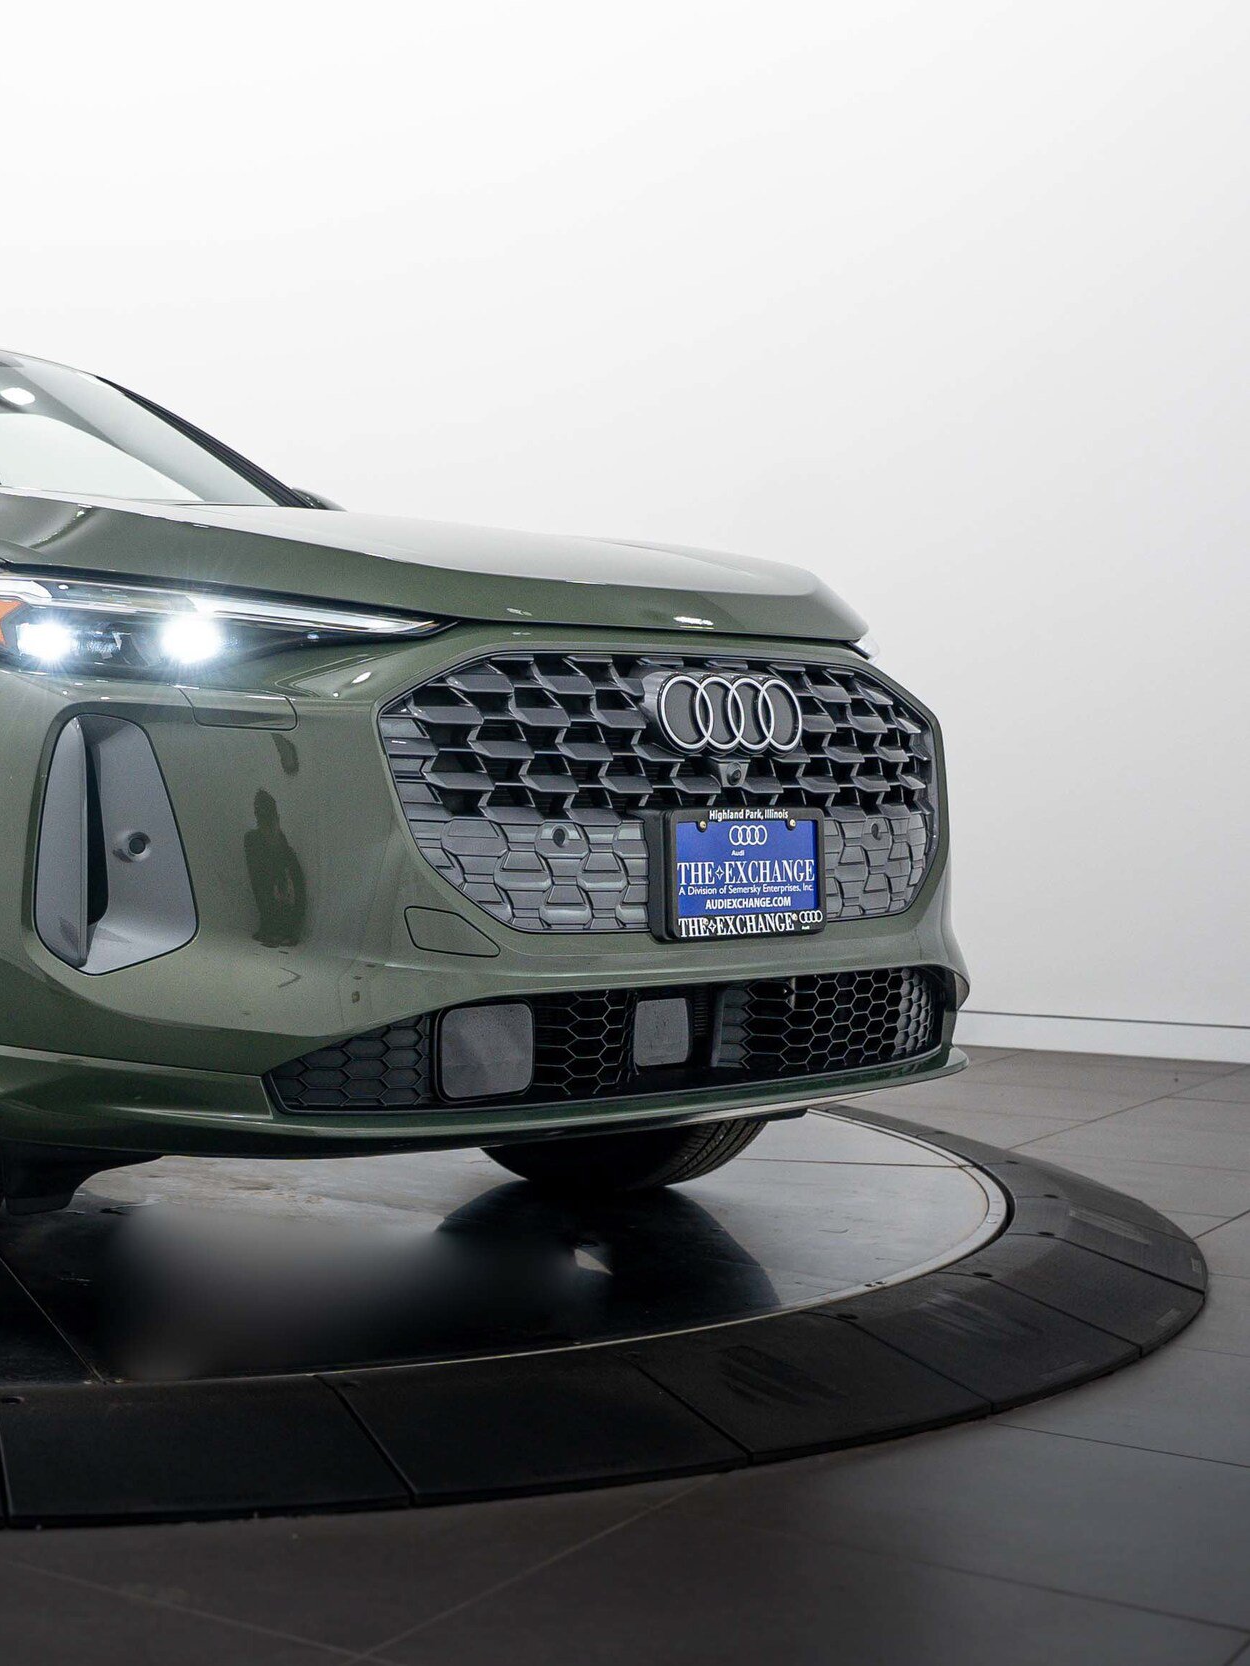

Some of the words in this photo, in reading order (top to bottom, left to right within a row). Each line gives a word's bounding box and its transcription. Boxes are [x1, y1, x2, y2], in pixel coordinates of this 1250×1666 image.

[709, 809, 744, 822] Highland
[745, 809, 764, 820] Park,
[764, 808, 789, 819] Illinois
[677, 861, 715, 885] THE
[723, 859, 815, 884] EXCHANGE
[678, 886, 686, 896] A
[687, 886, 717, 896] Division
[718, 885, 727, 894] of
[728, 884, 762, 896] Semersky
[802, 882, 814, 891] Inc.
[705, 896, 792, 910] AUDIEXCHANGE.COM
[678, 917, 710, 938] THE
[715, 911, 795, 936] EXCHANGE
